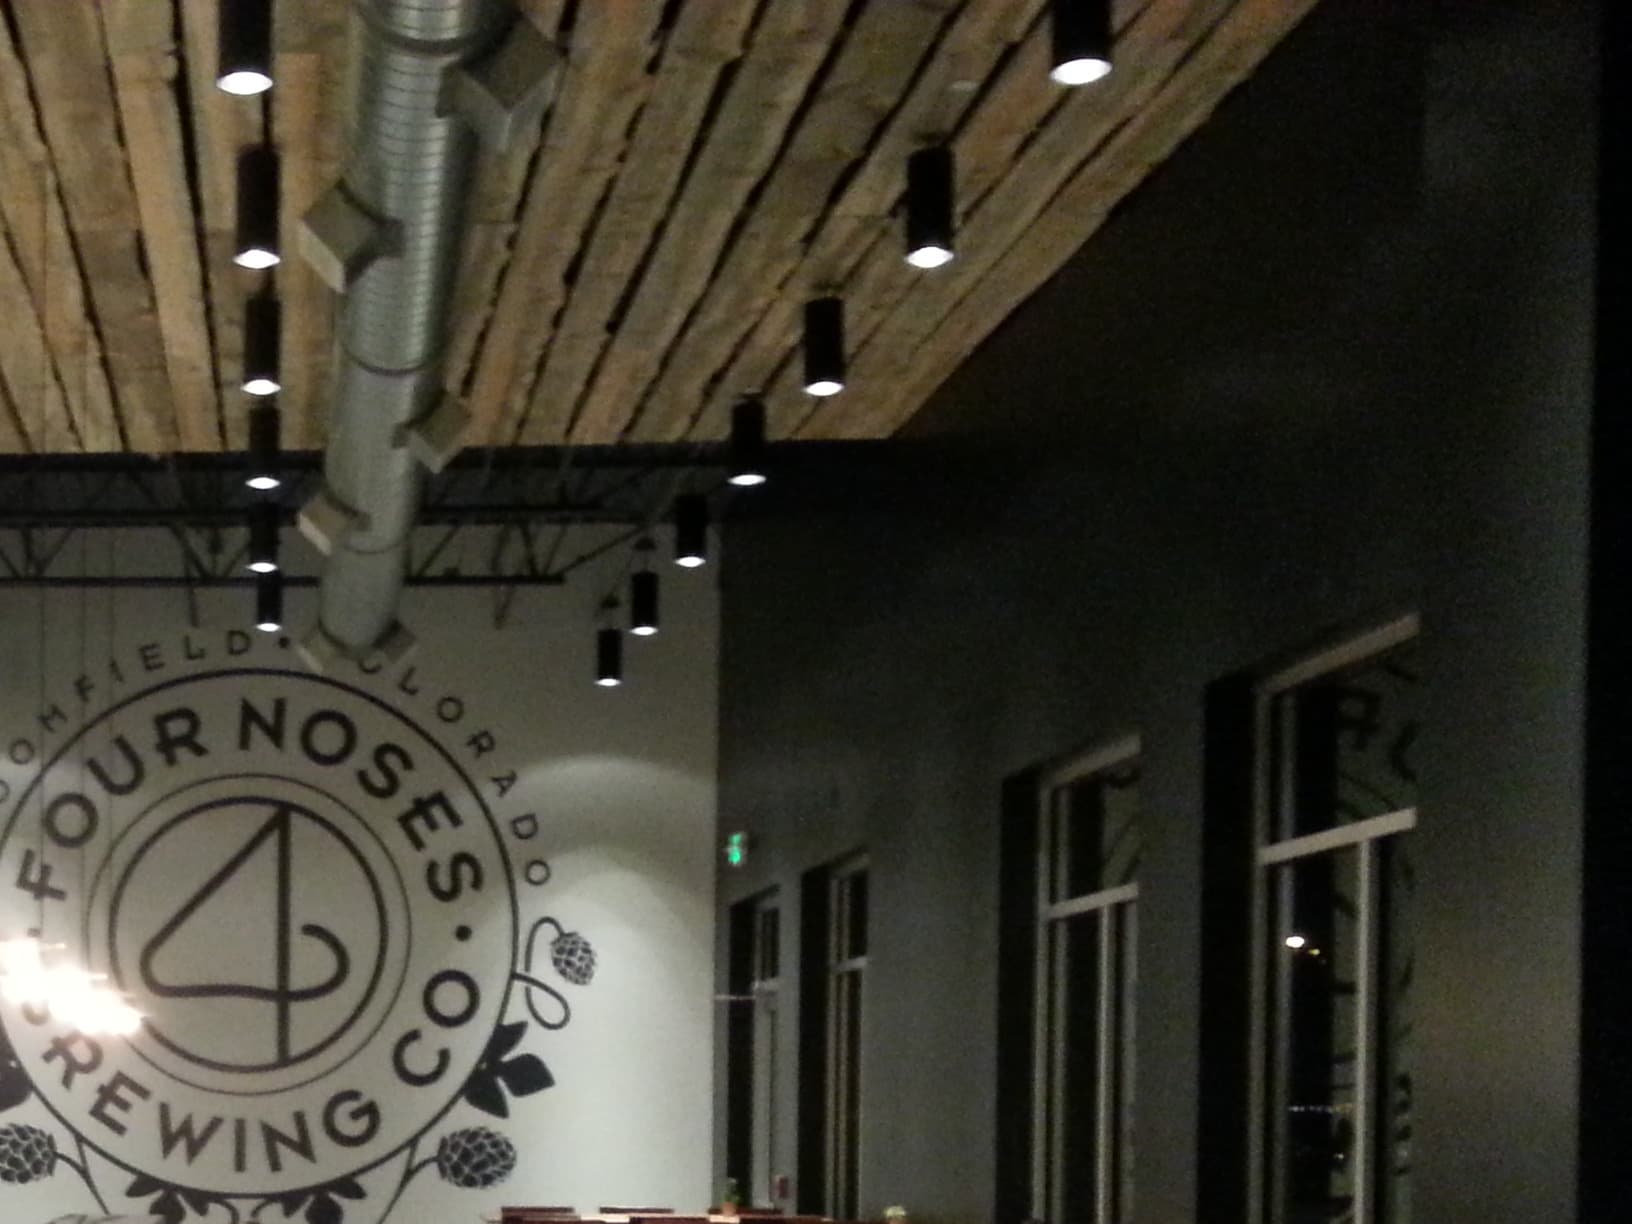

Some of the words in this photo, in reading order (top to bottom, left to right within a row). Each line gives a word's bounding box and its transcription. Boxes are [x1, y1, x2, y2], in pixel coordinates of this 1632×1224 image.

[18, 707, 208, 901] FOUR
[238, 698, 484, 902] NOSES
[358, 656, 551, 886] LORADO
[21, 998, 380, 1173] REWING
[393, 969, 480, 1087] CO
